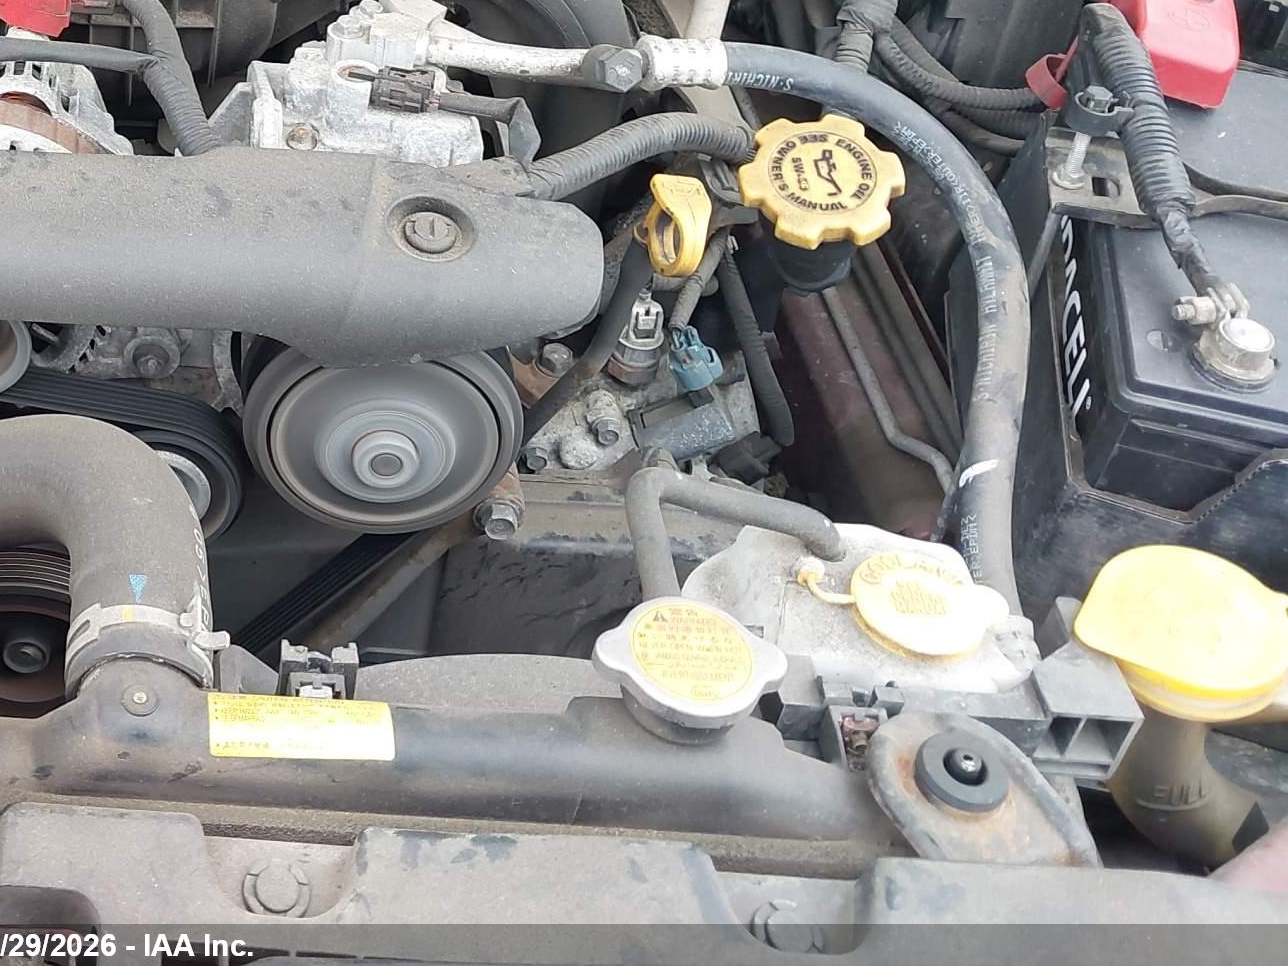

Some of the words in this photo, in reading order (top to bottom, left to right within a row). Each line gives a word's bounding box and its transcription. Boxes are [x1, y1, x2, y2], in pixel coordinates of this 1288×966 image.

[798, 134, 829, 145] SEE
[771, 140, 797, 192] OWNER'S
[835, 138, 873, 181] ENGINE
[787, 191, 849, 212] MANUAL
[849, 182, 871, 200] OIL
